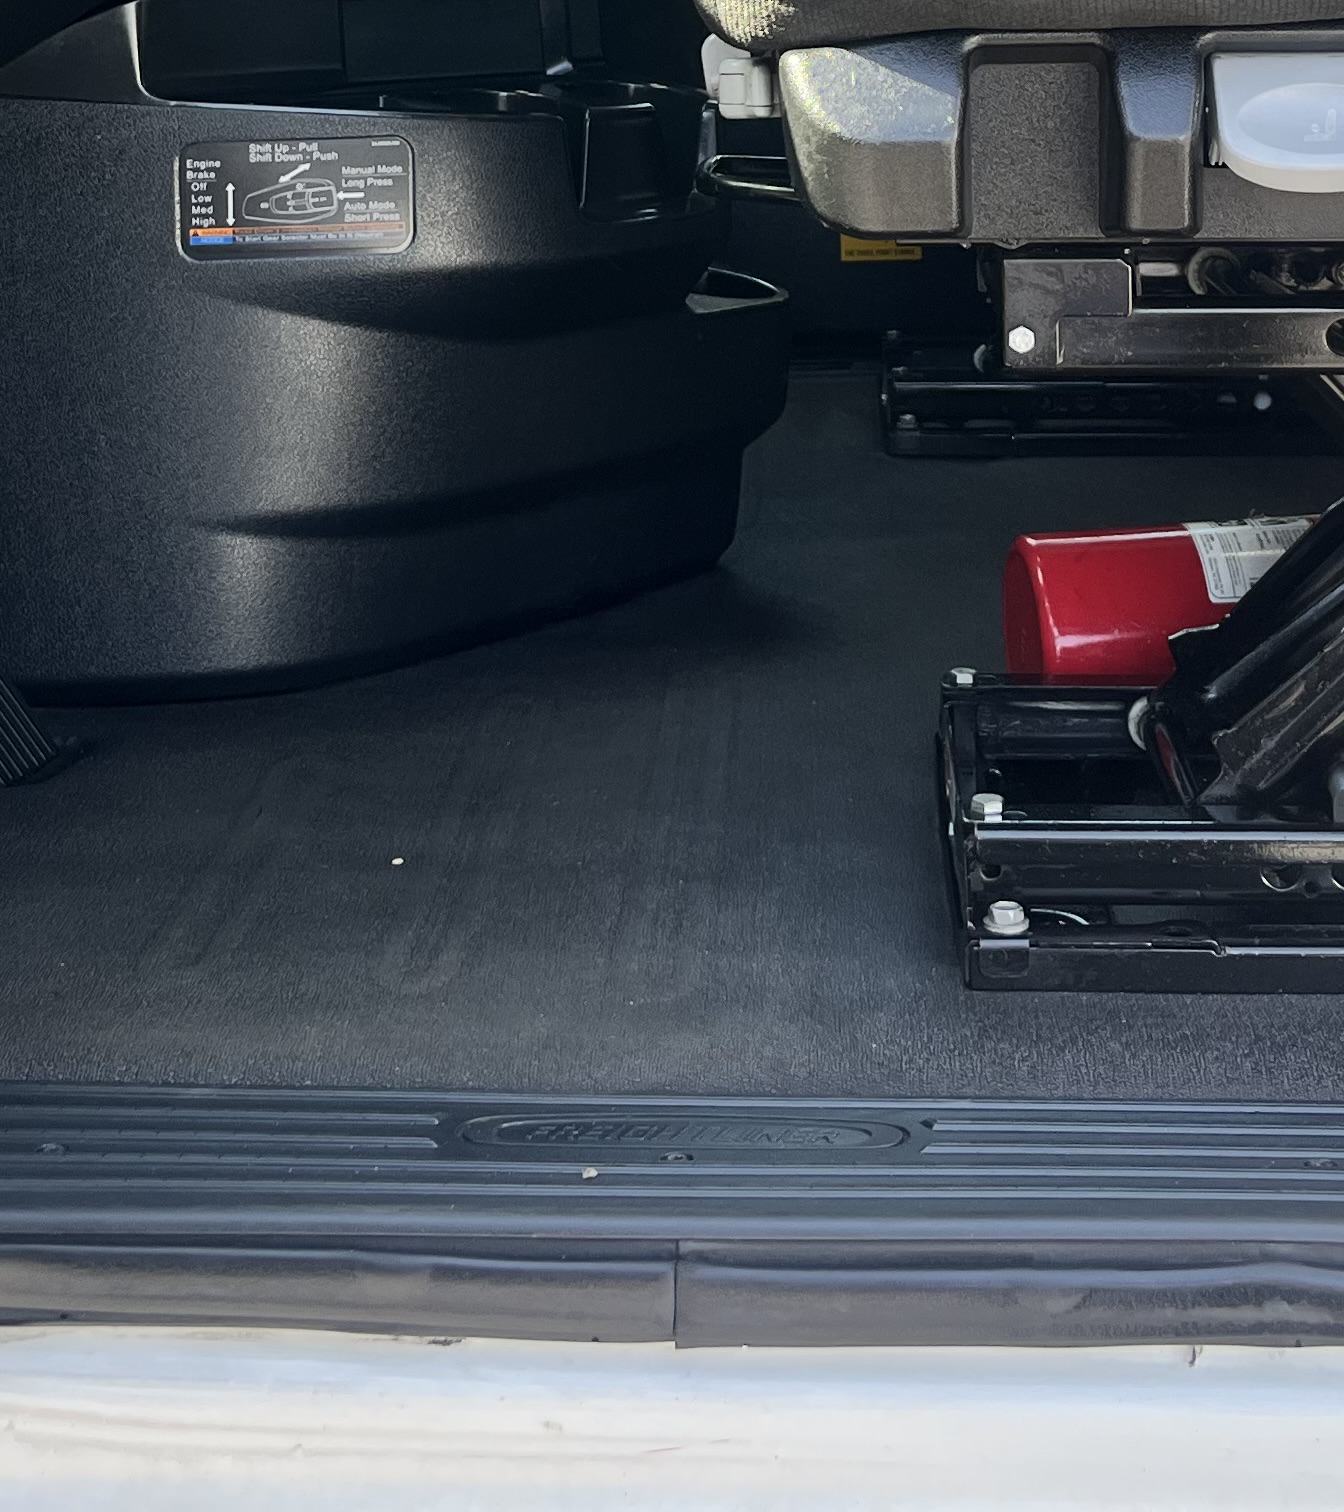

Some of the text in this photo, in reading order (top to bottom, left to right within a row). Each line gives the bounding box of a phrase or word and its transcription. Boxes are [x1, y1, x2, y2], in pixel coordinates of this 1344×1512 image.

[248, 143, 273, 153] Shift
[274, 143, 290, 153] Up
[298, 142, 319, 152] Pull
[248, 152, 273, 163] Shift
[274, 152, 304, 162] Down
[312, 151, 339, 161] Push
[186, 158, 222, 170] Engine
[341, 164, 403, 175] Manual Mode
[186, 170, 216, 180] Brake
[191, 181, 208, 192] Off
[341, 177, 394, 189] Long Press
[191, 194, 213, 204] Low
[191, 205, 214, 215] Med
[344, 200, 396, 211] Auto Mode
[191, 217, 216, 228] High
[344, 212, 401, 223] Short Press
